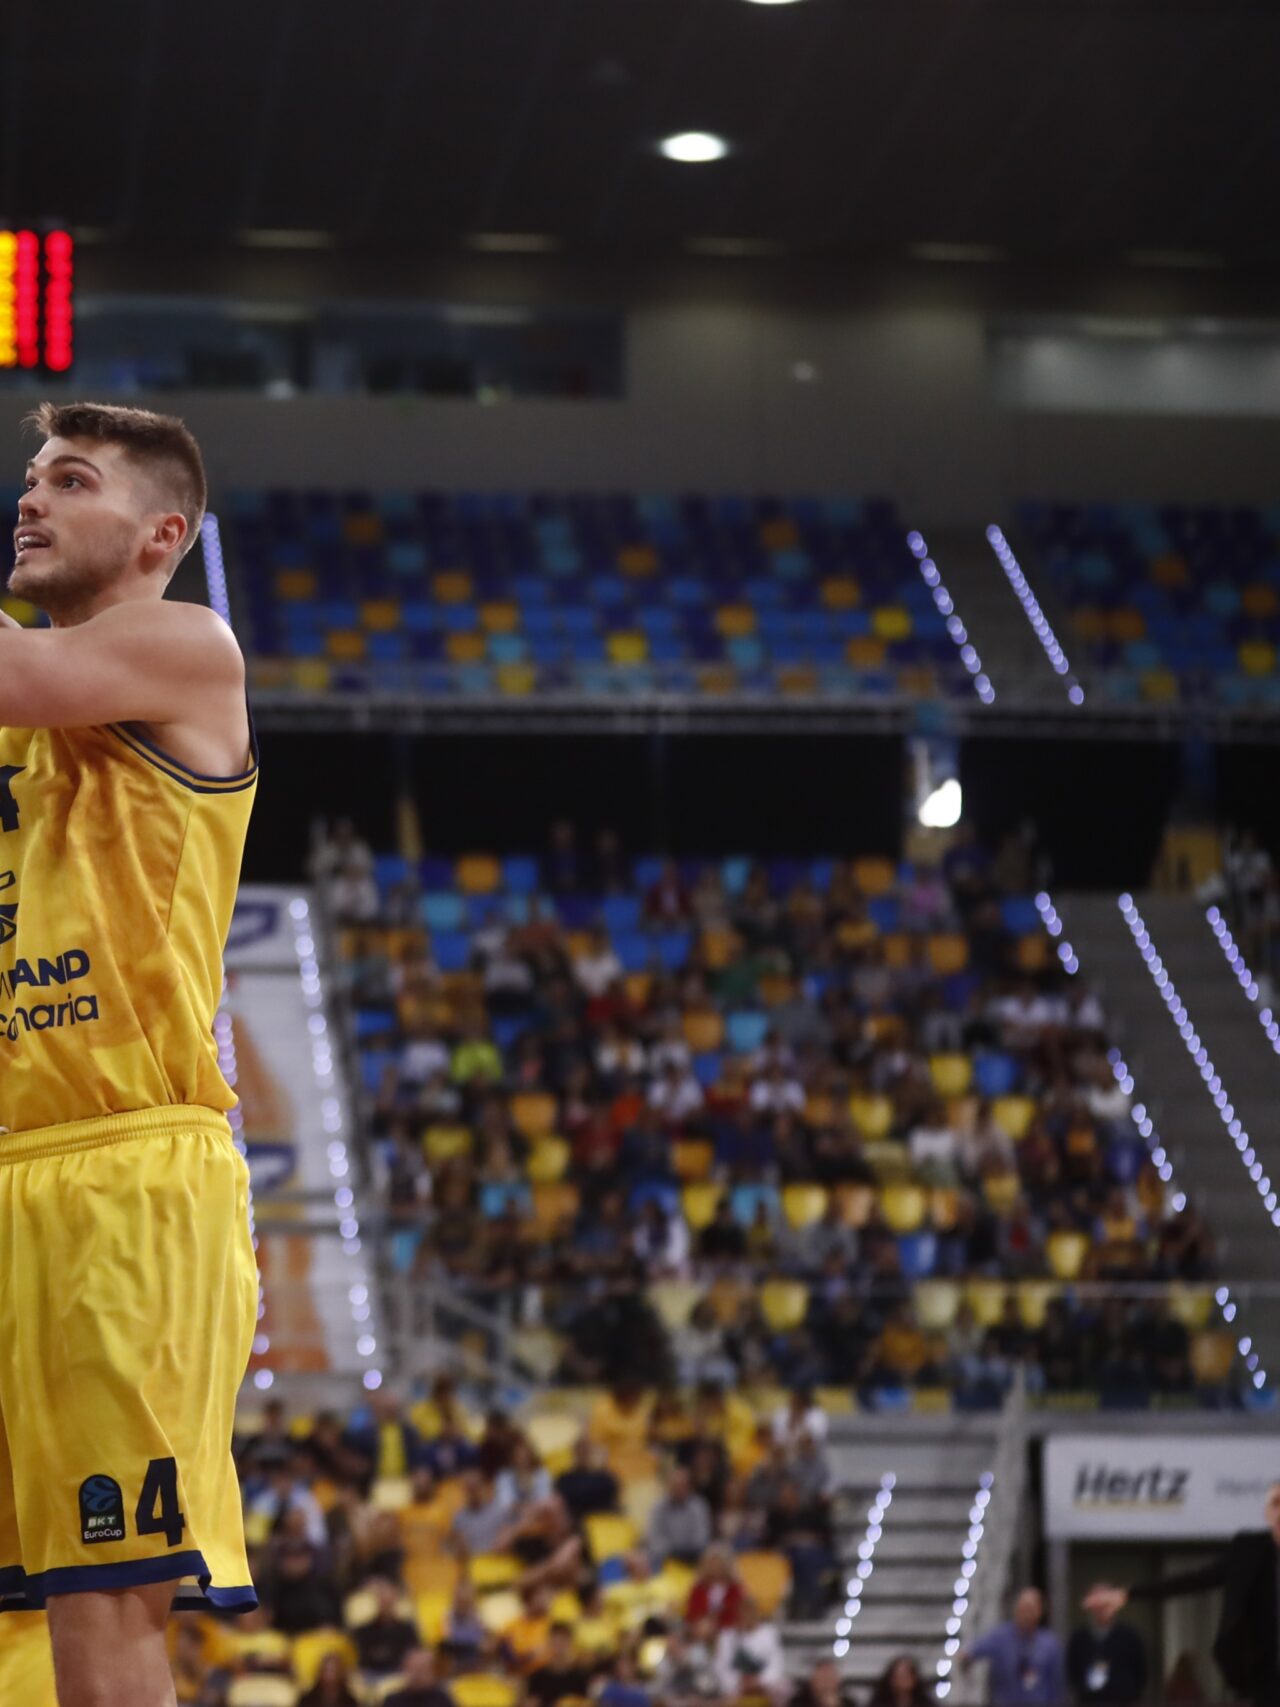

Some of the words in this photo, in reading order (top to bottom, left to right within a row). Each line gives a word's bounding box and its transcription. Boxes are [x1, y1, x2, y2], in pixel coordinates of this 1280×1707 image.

[1073, 1460, 1191, 1505] Hertz
[135, 1457, 186, 1547] 4
[83, 1528, 123, 1540] EuroCup
[87, 1516, 116, 1528] BKT
